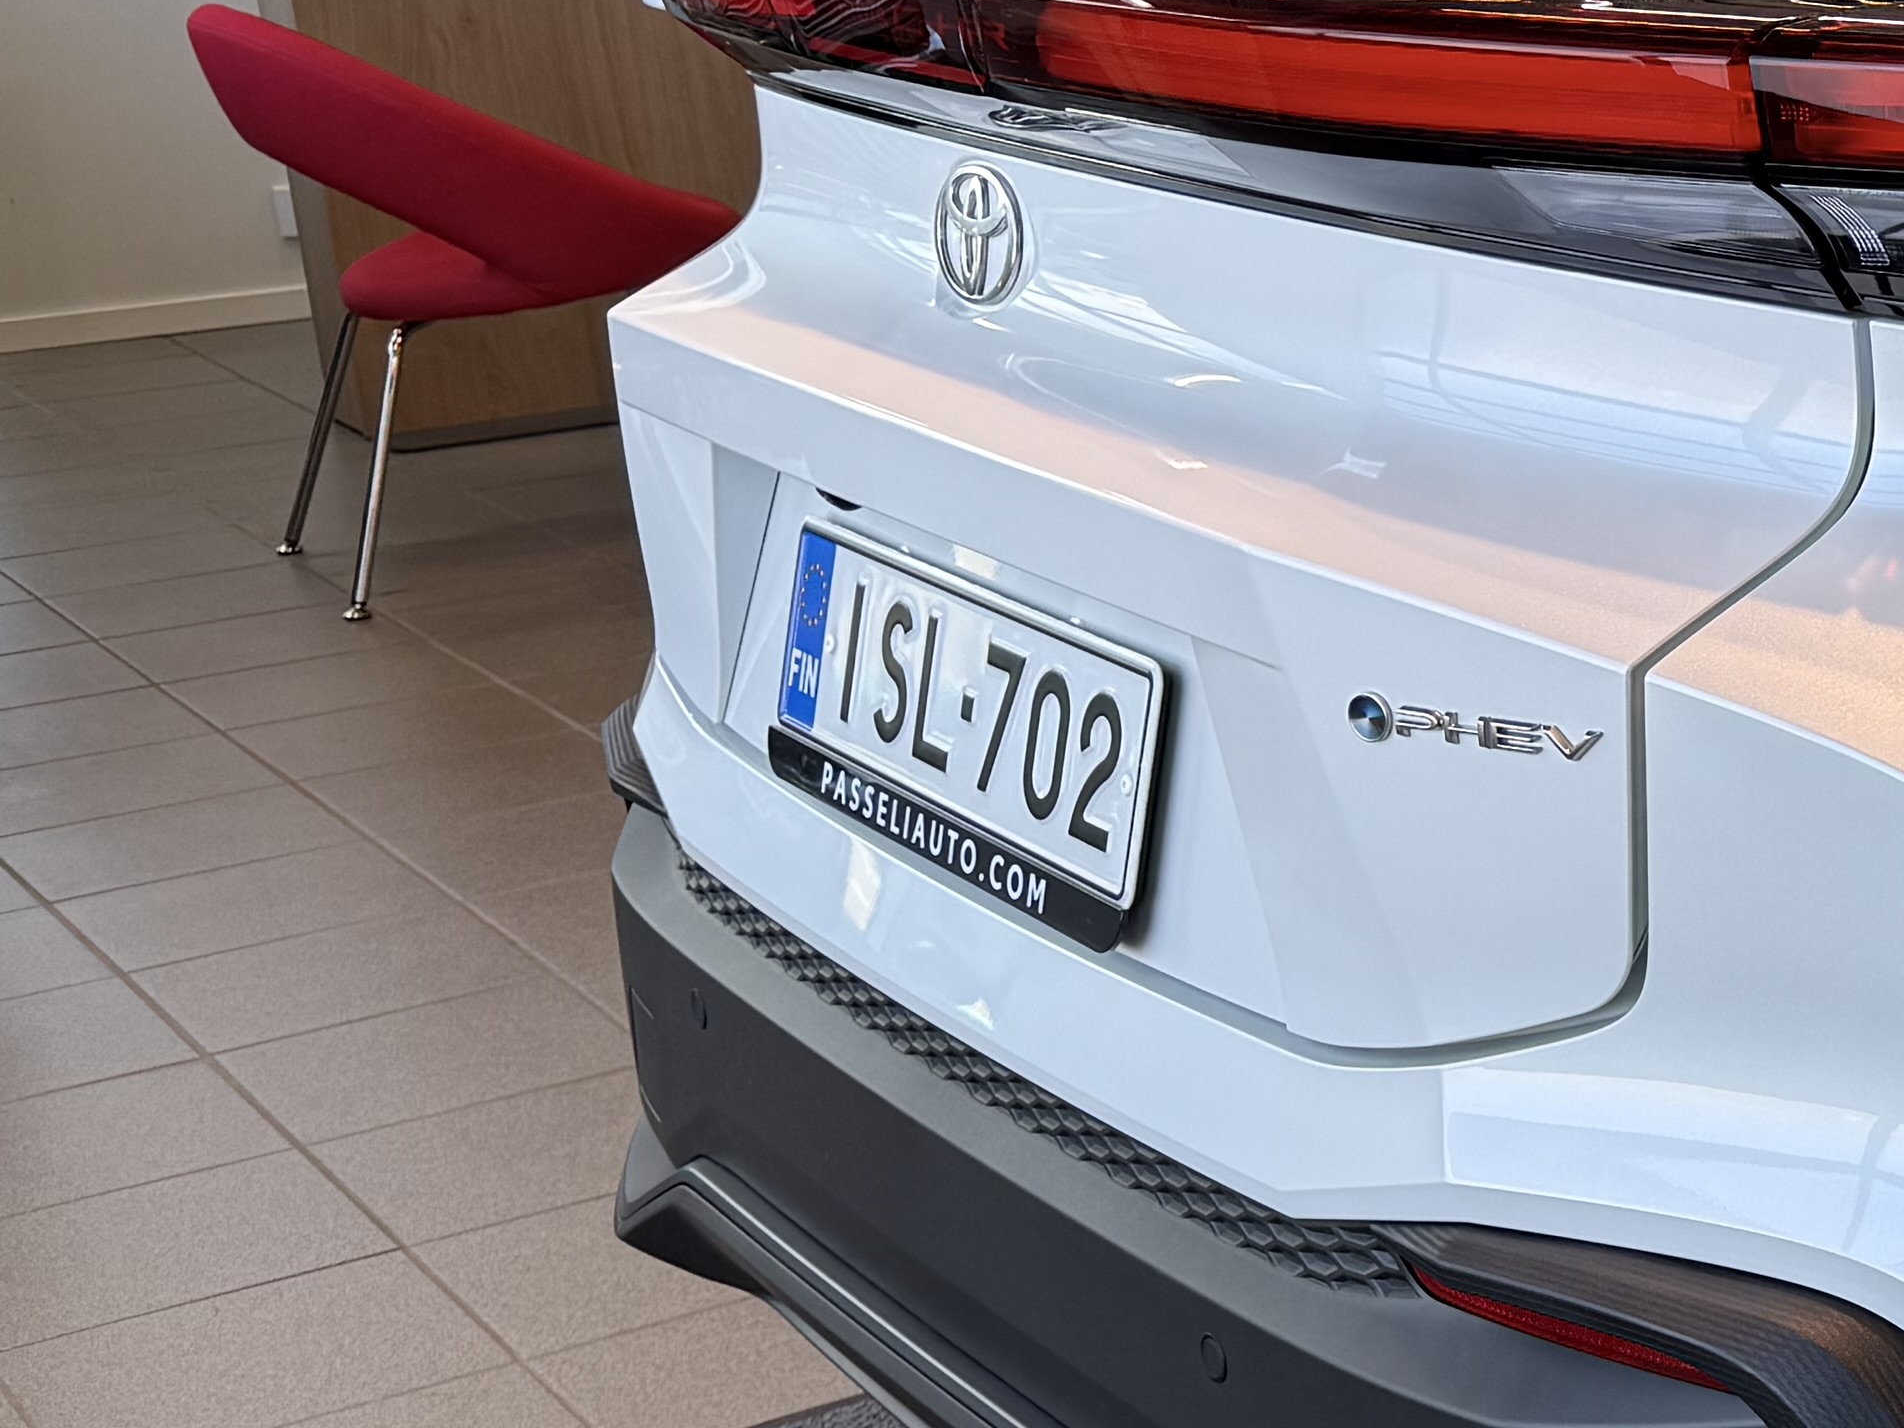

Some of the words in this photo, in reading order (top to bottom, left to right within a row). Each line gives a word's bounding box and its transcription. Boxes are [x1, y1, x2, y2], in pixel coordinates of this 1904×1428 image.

[788, 647, 821, 699] FIN
[840, 577, 1122, 853] ISL-702
[1394, 705, 1604, 761] PHEV
[821, 761, 1047, 915] PASSELIAUTO.COM
